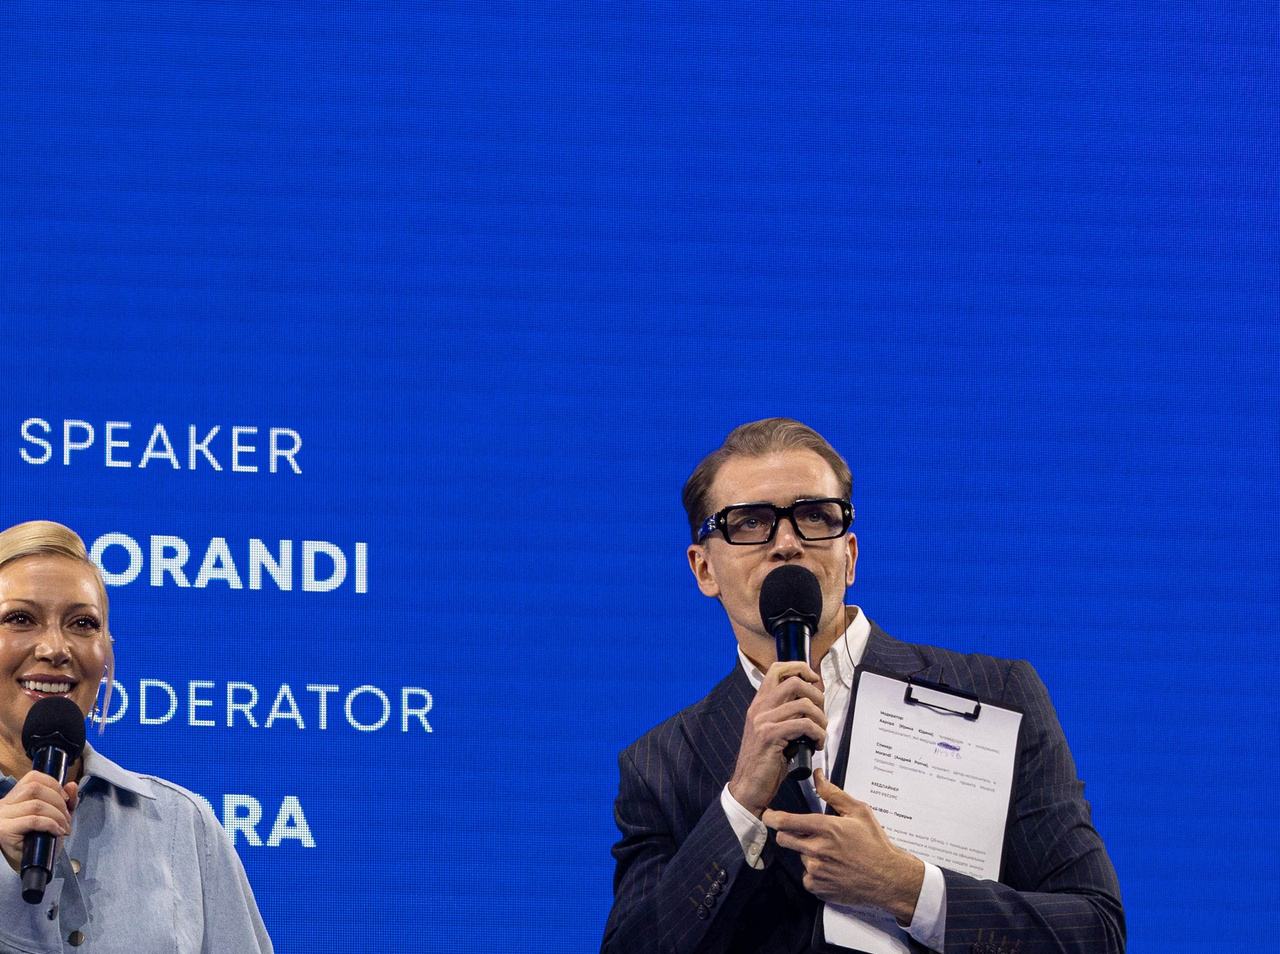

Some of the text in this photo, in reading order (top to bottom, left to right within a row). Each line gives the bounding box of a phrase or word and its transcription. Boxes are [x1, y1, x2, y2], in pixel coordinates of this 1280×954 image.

[19, 417, 303, 475] SPEAKER
[88, 532, 369, 594] ORANDI
[88, 677, 434, 733] ODERATOR
